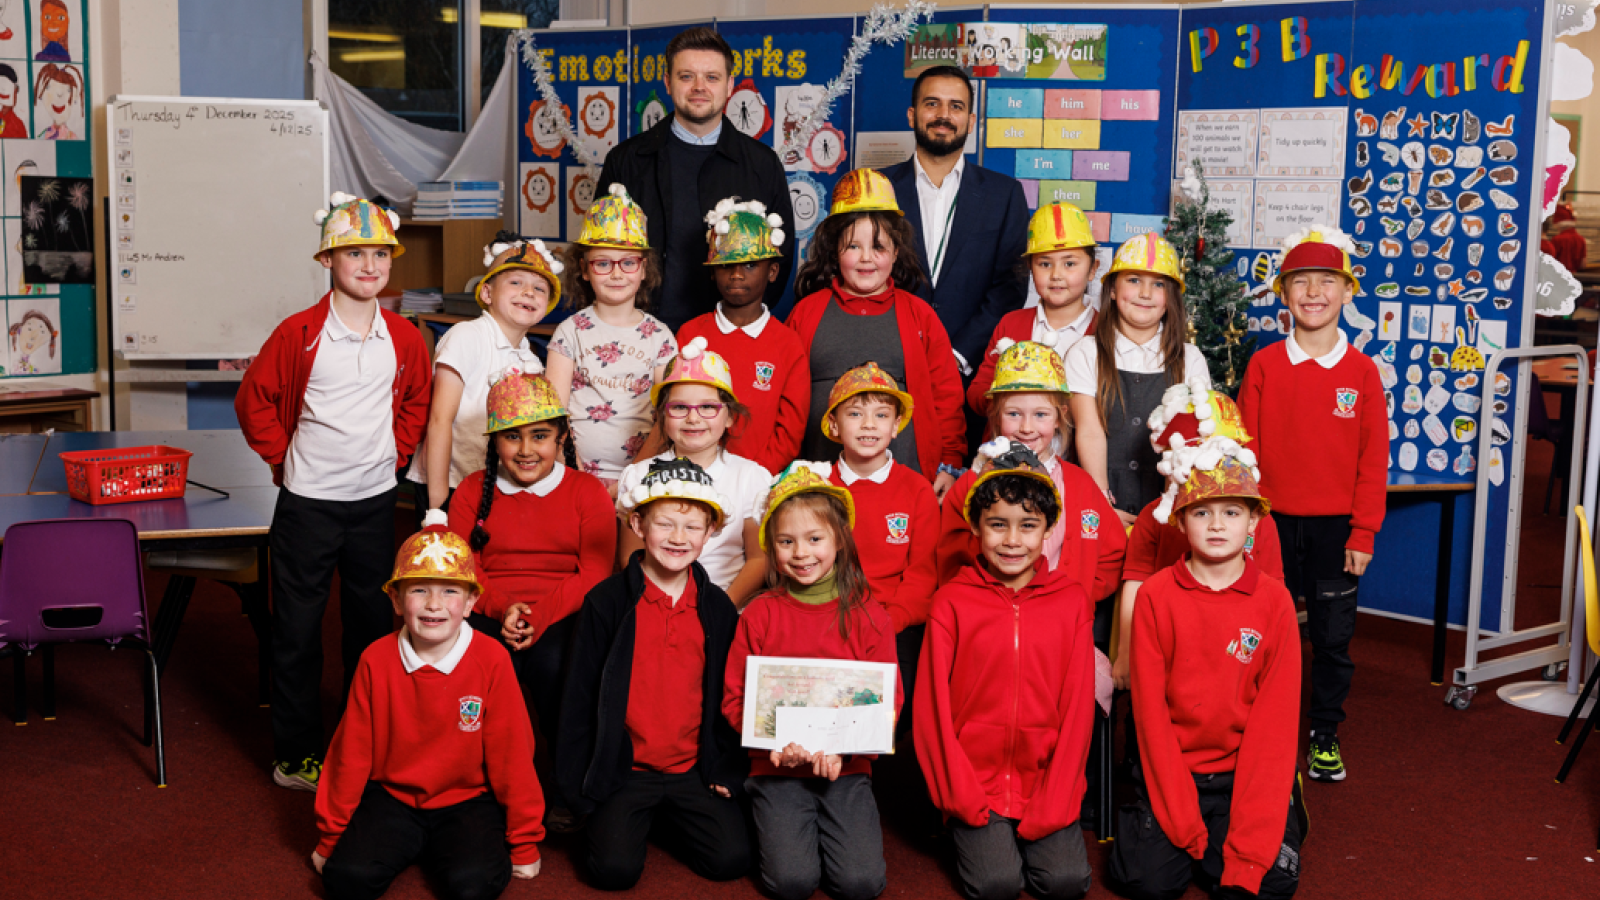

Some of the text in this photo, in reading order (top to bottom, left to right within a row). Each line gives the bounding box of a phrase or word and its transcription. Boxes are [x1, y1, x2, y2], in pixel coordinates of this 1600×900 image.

[1189, 16, 1311, 73] P 3 B
[731, 35, 808, 79] orks
[911, 44, 1094, 66] Literacy Working Wall
[1314, 39, 1531, 99] Reward
[1007, 97, 1140, 110] he him his
[117, 101, 180, 129] Thursday
[206, 105, 257, 120] December
[264, 108, 295, 120] 2025
[1004, 126, 1082, 139] she her
[1275, 138, 1327, 147] Tidy up quickly
[1203, 145, 1213, 154] get
[1033, 157, 1110, 171] I'm me
[1053, 188, 1081, 200] then
[1268, 203, 1284, 213] Keep
[1291, 203, 1308, 211] chair
[1310, 203, 1324, 213] legs
[1297, 215, 1314, 224] floor
